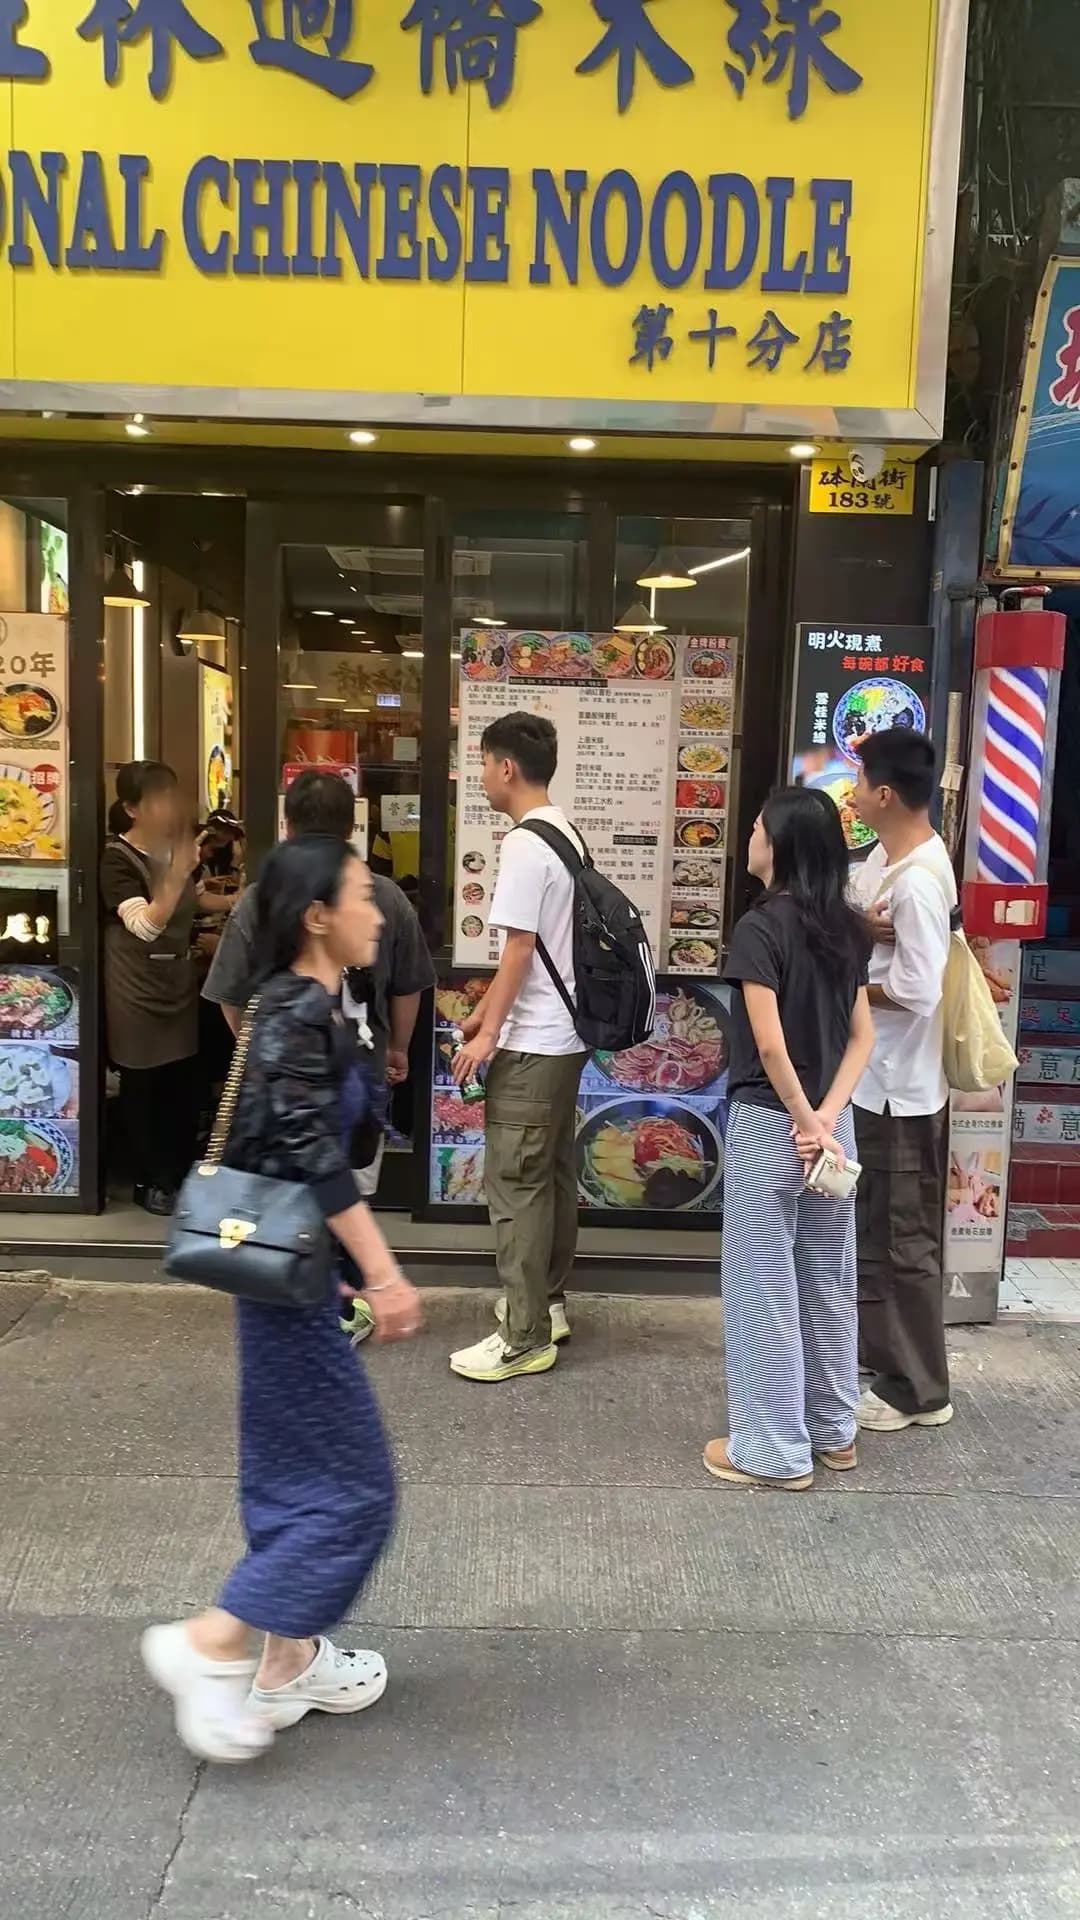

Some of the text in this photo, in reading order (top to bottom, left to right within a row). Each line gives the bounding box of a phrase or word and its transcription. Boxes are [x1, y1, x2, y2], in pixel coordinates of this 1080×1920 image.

[0, 150, 853, 293] NAL CHINESE NOODLE
[628, 303, 853, 373] 第十分店
[808, 630, 883, 652] 明火現煮
[842, 656, 925, 673] 每碗都好食
[1038, 1053, 1062, 1080] 意
